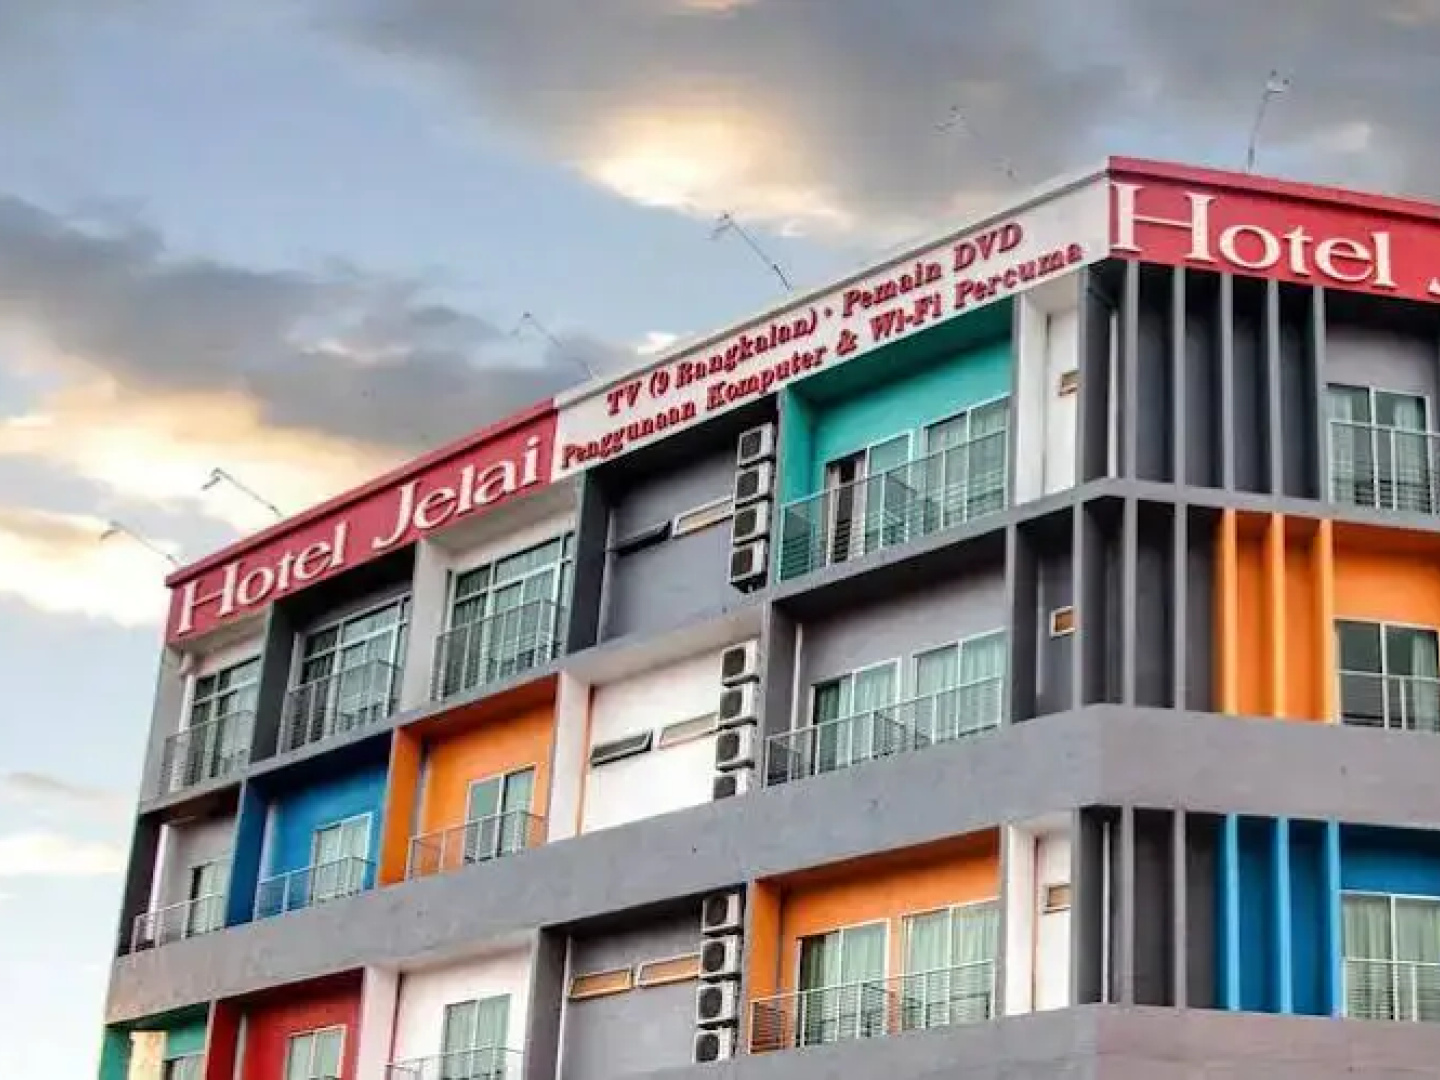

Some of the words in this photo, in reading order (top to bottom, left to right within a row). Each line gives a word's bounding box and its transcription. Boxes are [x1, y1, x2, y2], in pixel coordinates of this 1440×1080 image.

[607, 381, 641, 416] TV
[843, 262, 942, 318] Pemain
[954, 222, 1023, 272] DVD
[1113, 182, 1394, 287] Hotel
[561, 401, 696, 470] Penggunaan
[707, 346, 827, 411] Komputer
[837, 328, 858, 356] &
[870, 293, 942, 341] Wi-Fi
[954, 243, 1083, 309] Percuma
[176, 521, 349, 635] Hotel
[372, 435, 541, 549] Jelai
